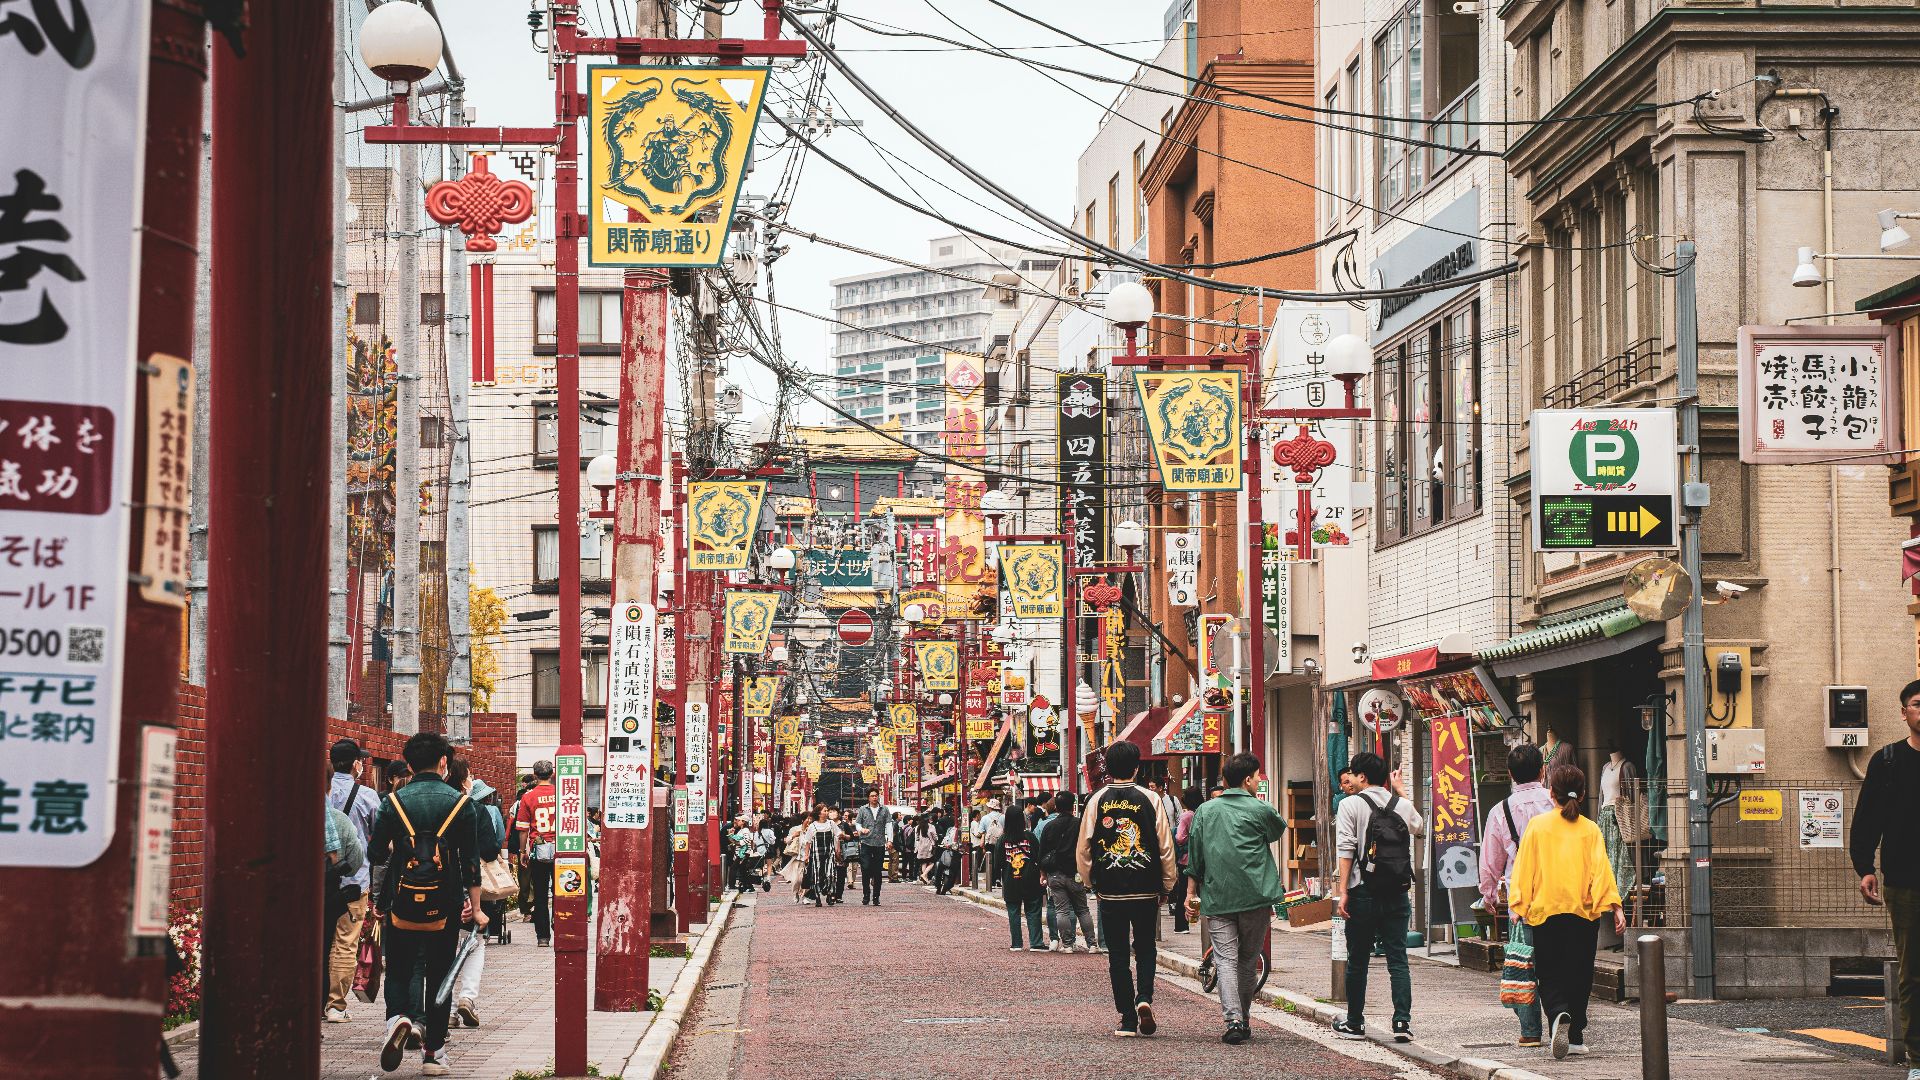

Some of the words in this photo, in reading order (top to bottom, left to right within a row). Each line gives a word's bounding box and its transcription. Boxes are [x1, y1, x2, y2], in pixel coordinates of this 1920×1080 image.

[607, 228, 711, 254] 関帝廟通り
[1761, 355, 1788, 410] 焼売
[1800, 354, 1828, 440] 馬餃子
[1841, 356, 1868, 440] 小龍包
[0, 416, 102, 454] 休を
[1570, 418, 1597, 431] Ace
[1608, 419, 1638, 431] 24h
[1586, 434, 1625, 476] P
[1172, 468, 1234, 483] 関帝廟通り
[1573, 483, 1637, 491] エースパーク
[1325, 507, 1344, 519] 2F
[1545, 497, 1592, 545] 空
[0, 536, 68, 568] そば
[696, 553, 742, 565] 関帝廟通り
[913, 533, 924, 582] 食べ放題
[926, 534, 937, 582] オーダー式
[1180, 551, 1194, 584] 隕石
[64, 585, 95, 610] 1F
[1020, 604, 1059, 614] 関帝廟通り
[729, 640, 762, 650] 関帝廟通り
[623, 625, 641, 714] 隕石直売所
[0, 711, 94, 744] と案内
[691, 714, 700, 763] 隕石直売所
[973, 722, 992, 731] 山東
[1204, 717, 1219, 747] 文字
[561, 778, 580, 833] 関帝廟
[608, 813, 645, 823] 車に注意
[677, 800, 685, 824] 関帝廟
